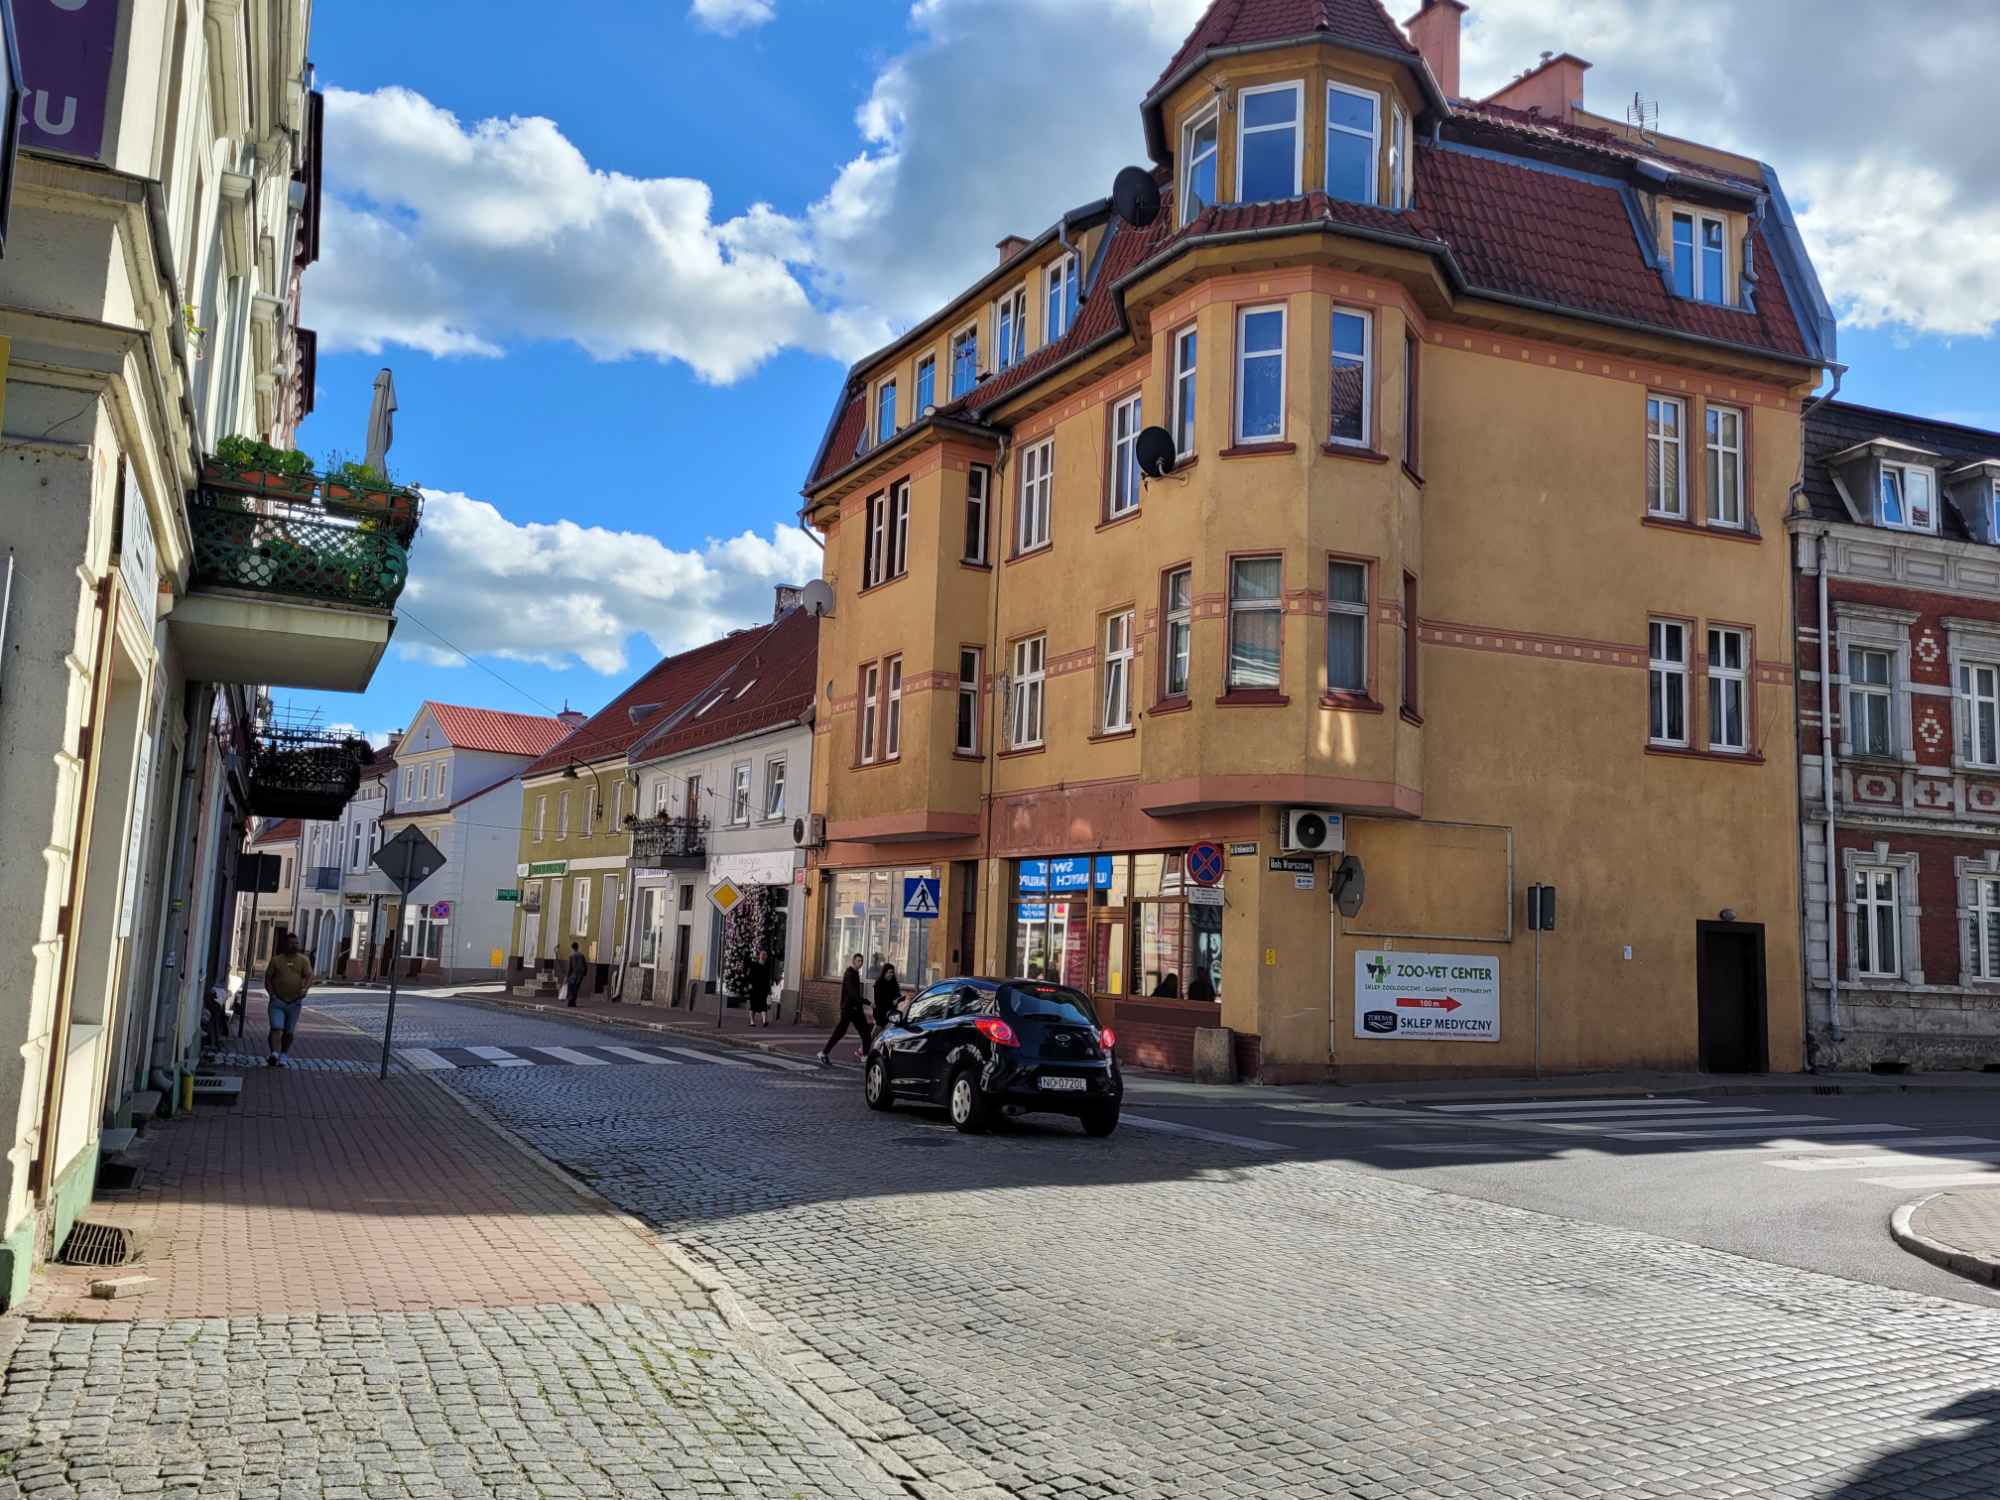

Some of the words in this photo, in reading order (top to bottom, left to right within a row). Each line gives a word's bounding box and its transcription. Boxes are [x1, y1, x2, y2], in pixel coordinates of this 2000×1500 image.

[1397, 964, 1448, 979] ZOO-VET
[1450, 966, 1492, 981] CENTER
[1420, 999, 1432, 1007] 100
[1400, 1017, 1432, 1029] SKLEP
[1434, 1018, 1493, 1031] MEDYCZNY
